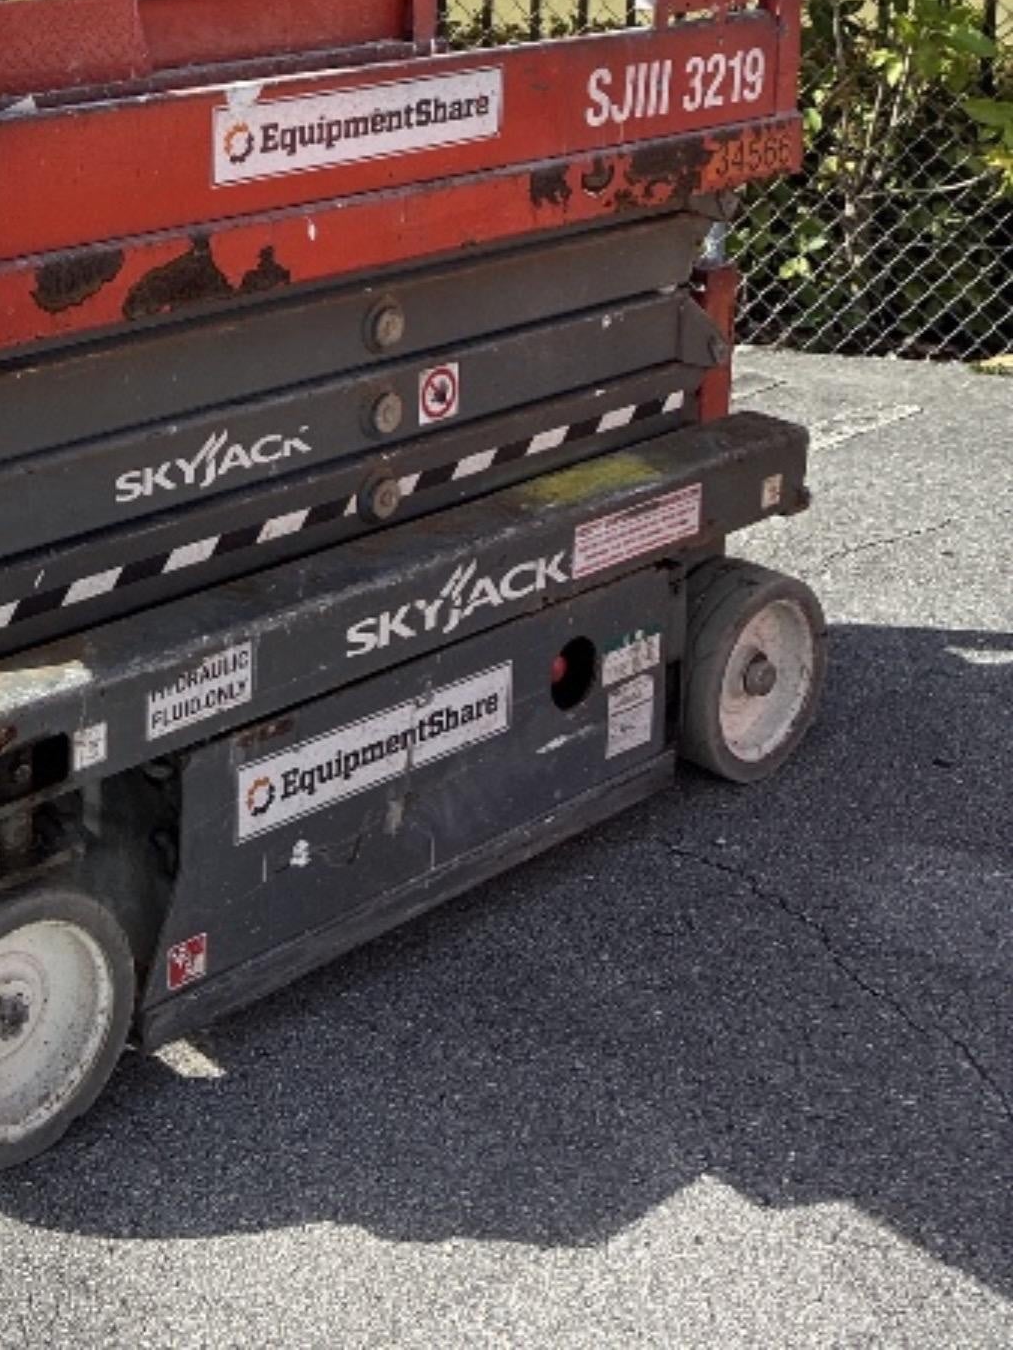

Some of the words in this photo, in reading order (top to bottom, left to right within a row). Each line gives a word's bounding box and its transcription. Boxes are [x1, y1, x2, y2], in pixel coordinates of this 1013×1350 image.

[682, 48, 765, 112] 3219
[259, 95, 490, 156] EquipmentShare
[346, 551, 570, 658] SKYJACK
[152, 696, 201, 730] FLUID
[280, 692, 499, 800] EquipmentShare
